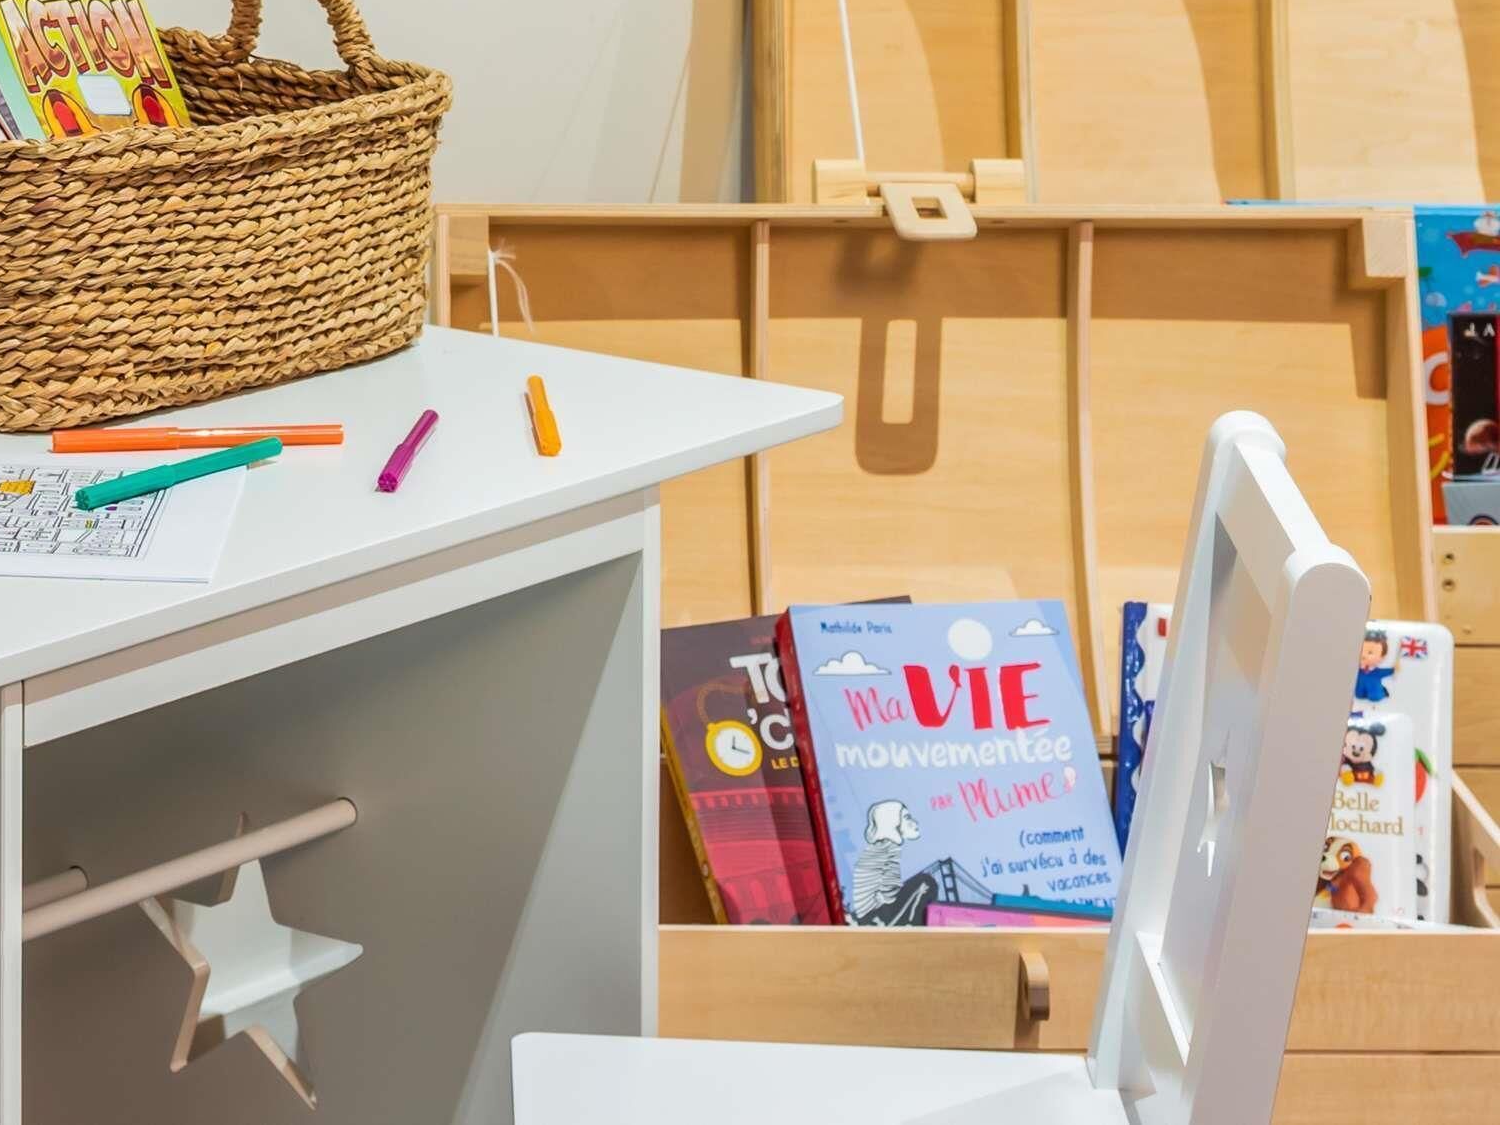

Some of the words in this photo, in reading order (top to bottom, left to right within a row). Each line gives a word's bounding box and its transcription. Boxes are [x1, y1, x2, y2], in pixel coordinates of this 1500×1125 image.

[844, 686, 910, 732] Ma
[902, 661, 1052, 731] VIE
[834, 725, 1075, 769] mouvementée
[956, 771, 1060, 823] Plume
[1332, 790, 1380, 812] Belle
[1330, 813, 1405, 837] lochard
[1008, 851, 1064, 875] survécu
[1083, 847, 1108, 867] des
[1046, 871, 1112, 893] vacances
